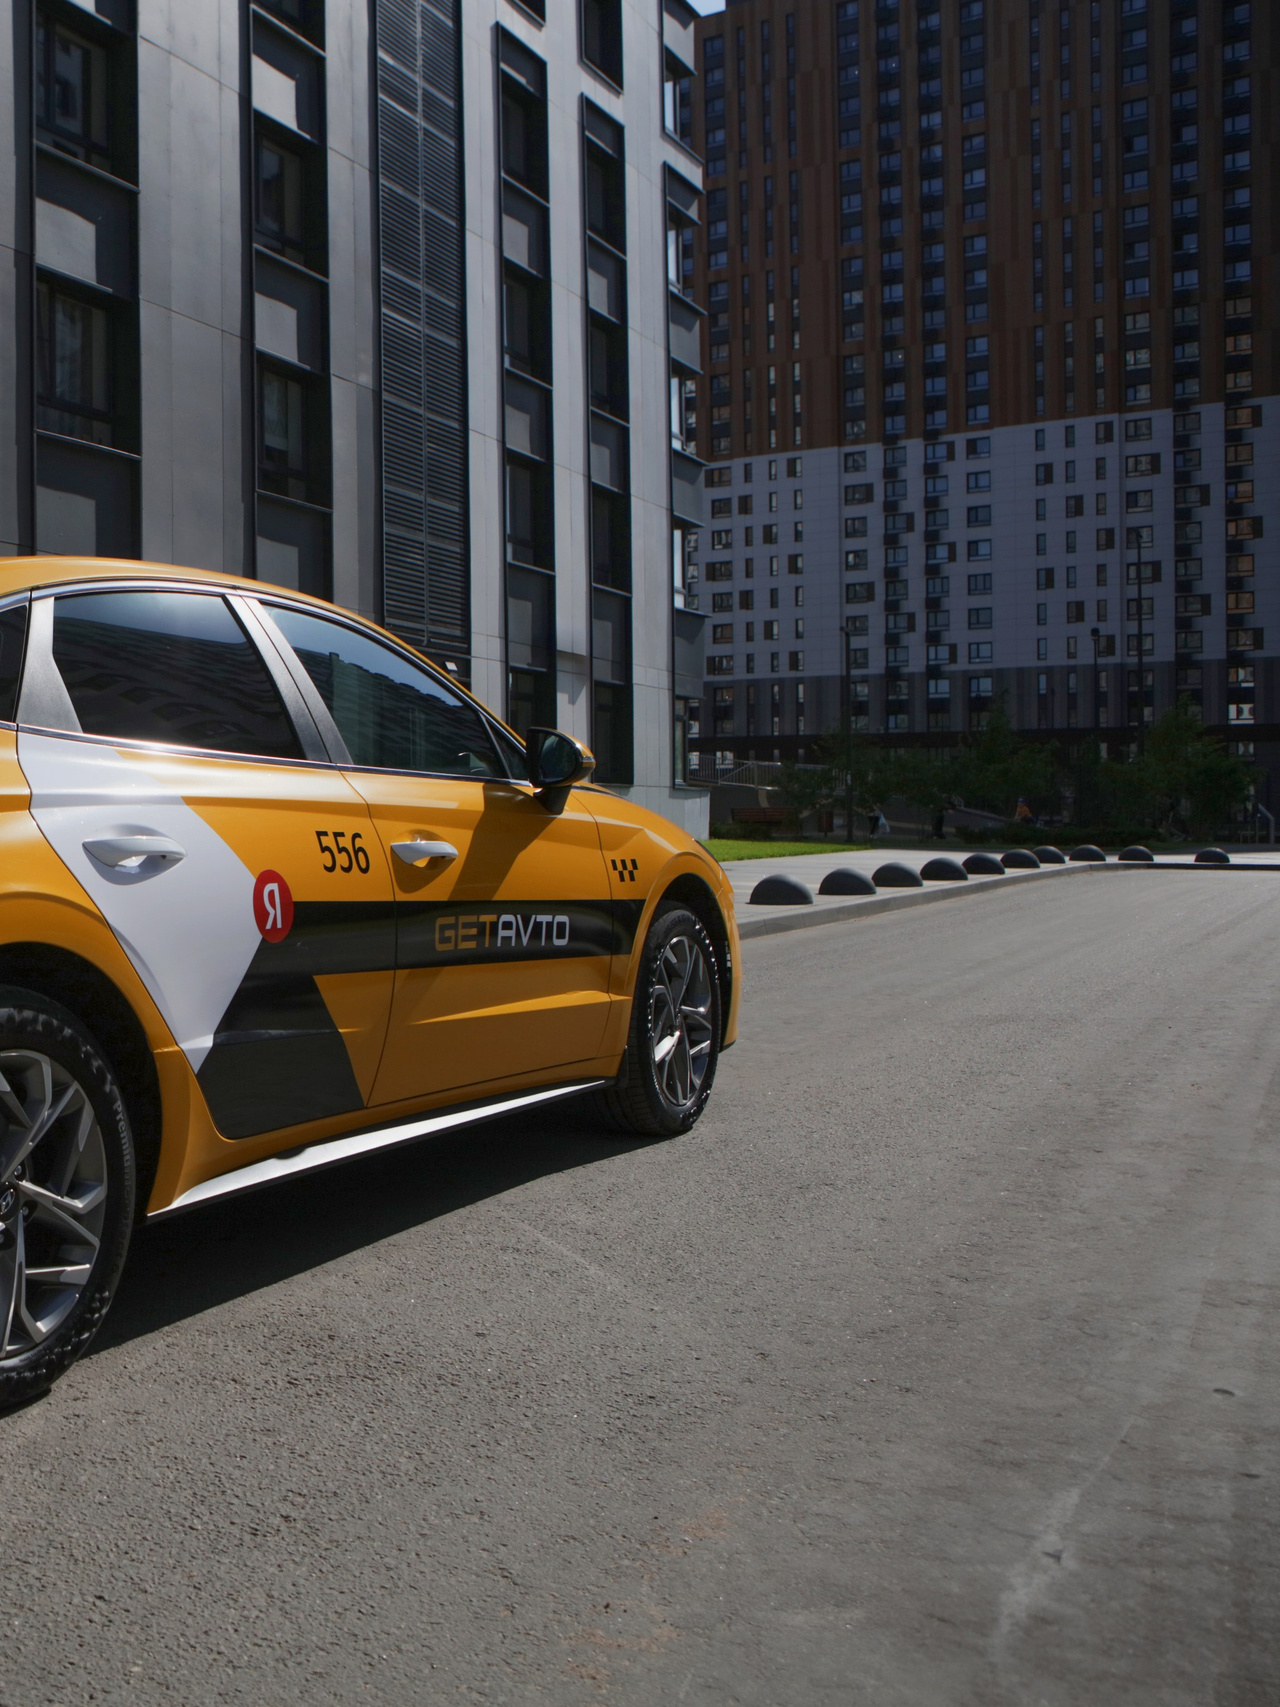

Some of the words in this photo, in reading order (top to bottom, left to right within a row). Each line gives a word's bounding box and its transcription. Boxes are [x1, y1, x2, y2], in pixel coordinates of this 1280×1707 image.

[315, 830, 370, 875] 556
[263, 883, 282, 930] Я
[435, 914, 570, 951] GETAVTO
